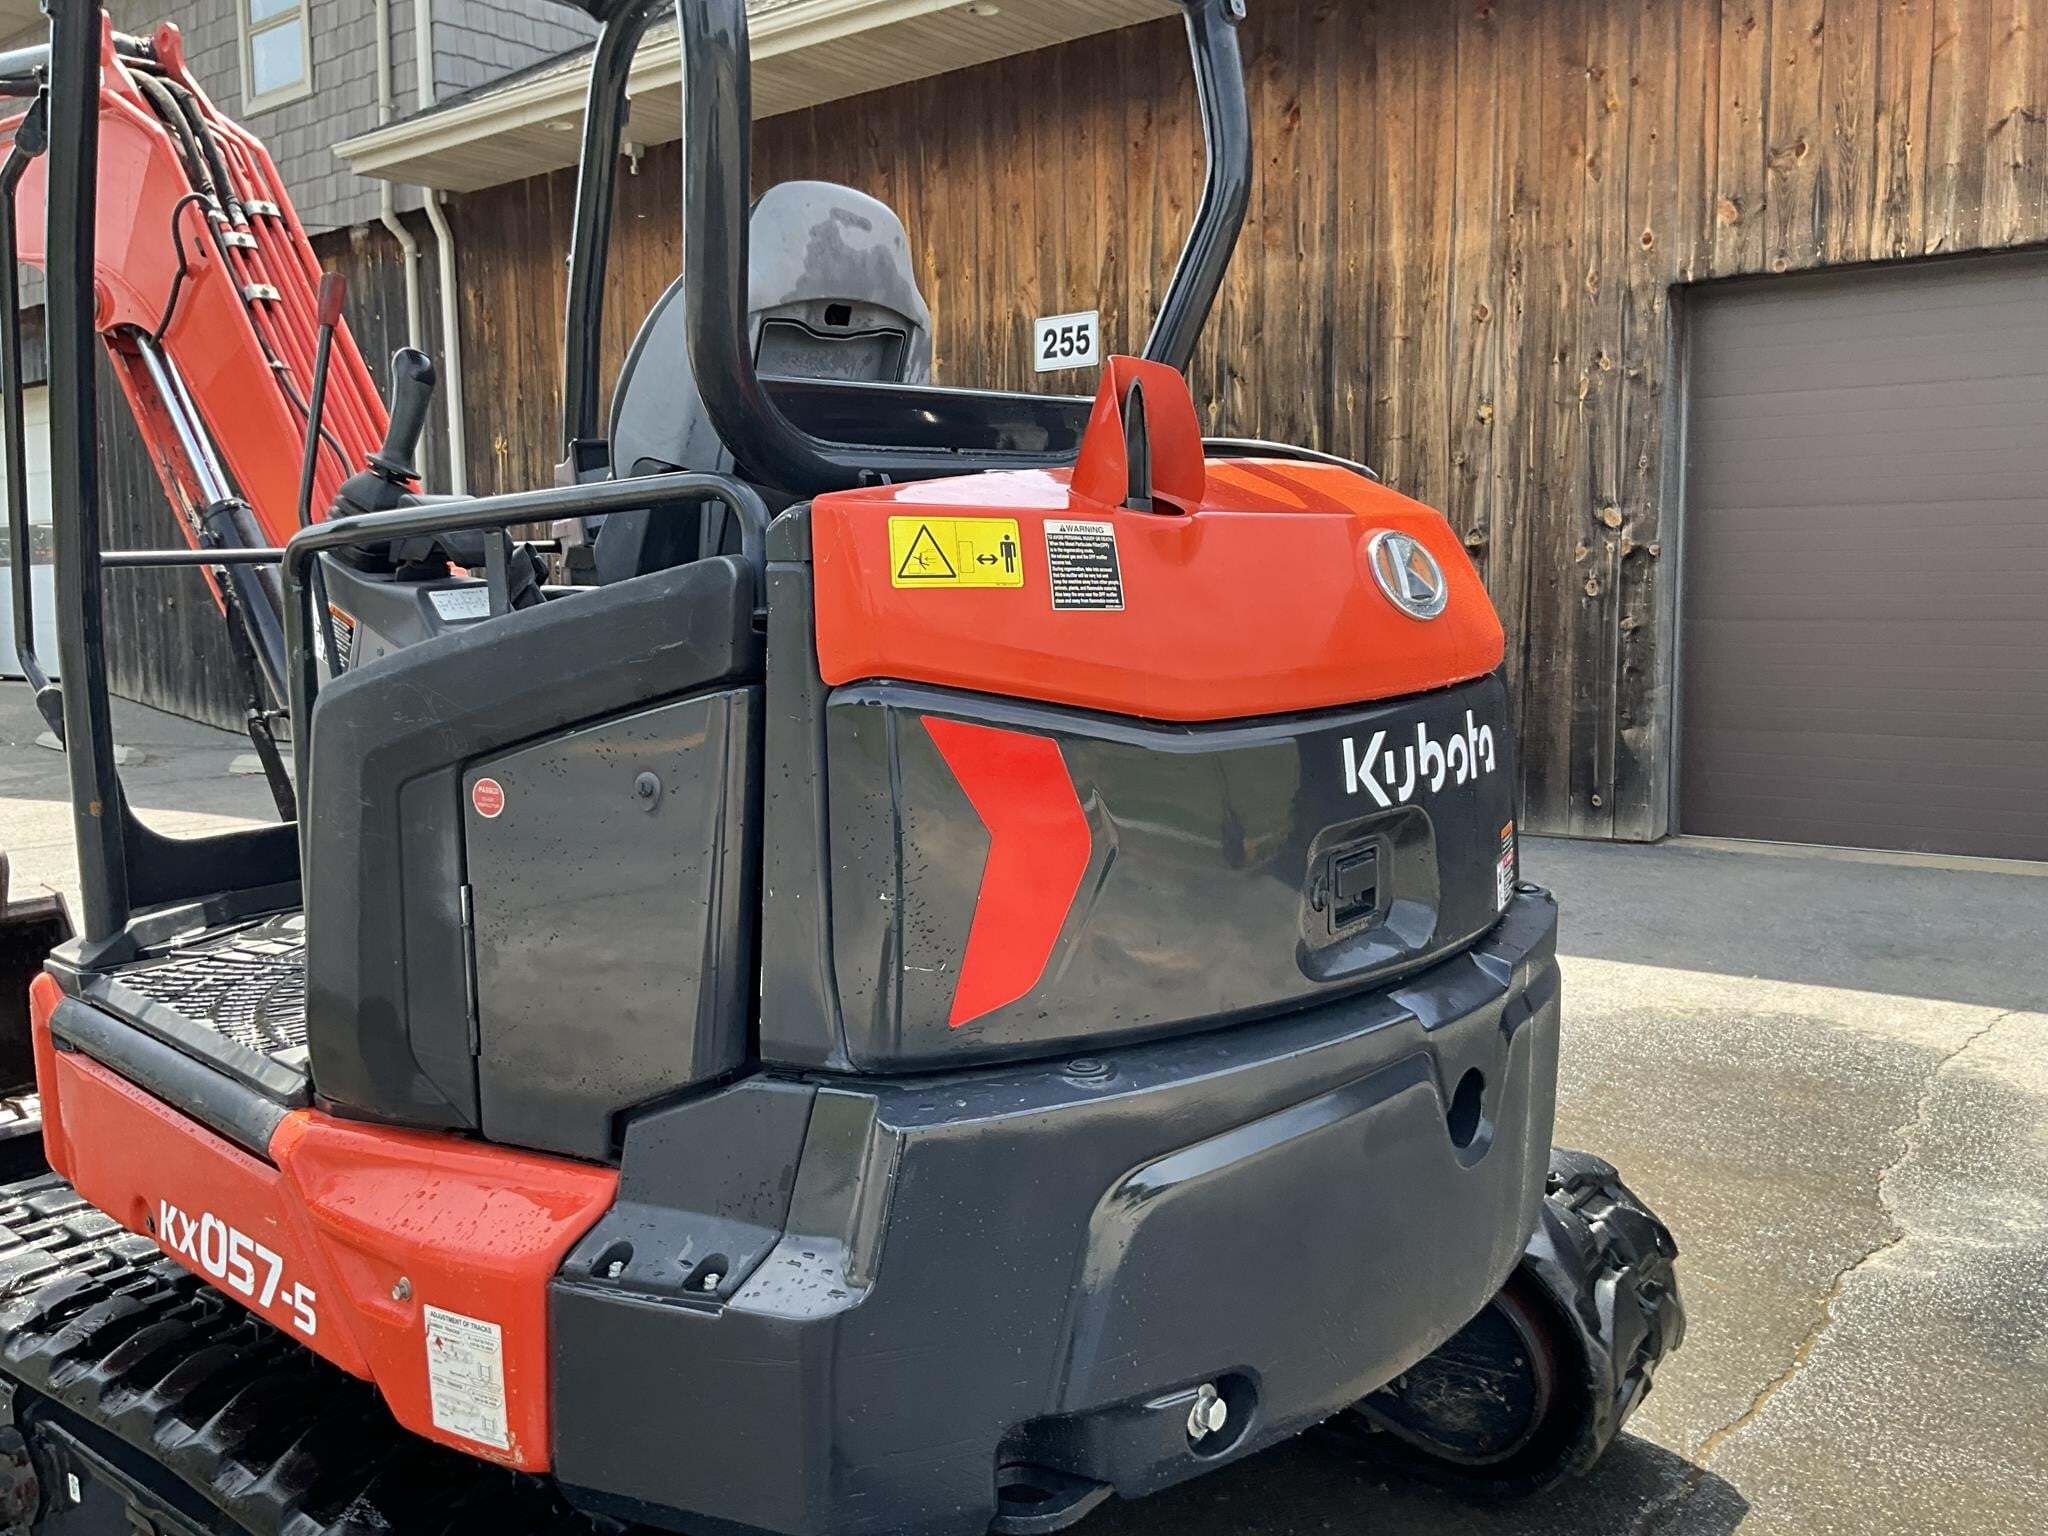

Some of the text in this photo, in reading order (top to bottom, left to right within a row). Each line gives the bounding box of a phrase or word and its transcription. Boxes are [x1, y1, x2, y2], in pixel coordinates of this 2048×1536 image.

[1043, 324, 1090, 359] 255
[1065, 525, 1104, 533] WARNING
[1342, 708, 1496, 808] Kubota
[160, 1199, 317, 1336] KX057-5
[430, 1311, 462, 1325] ADJUSTMENT
[471, 1323, 492, 1334] TRACKS
